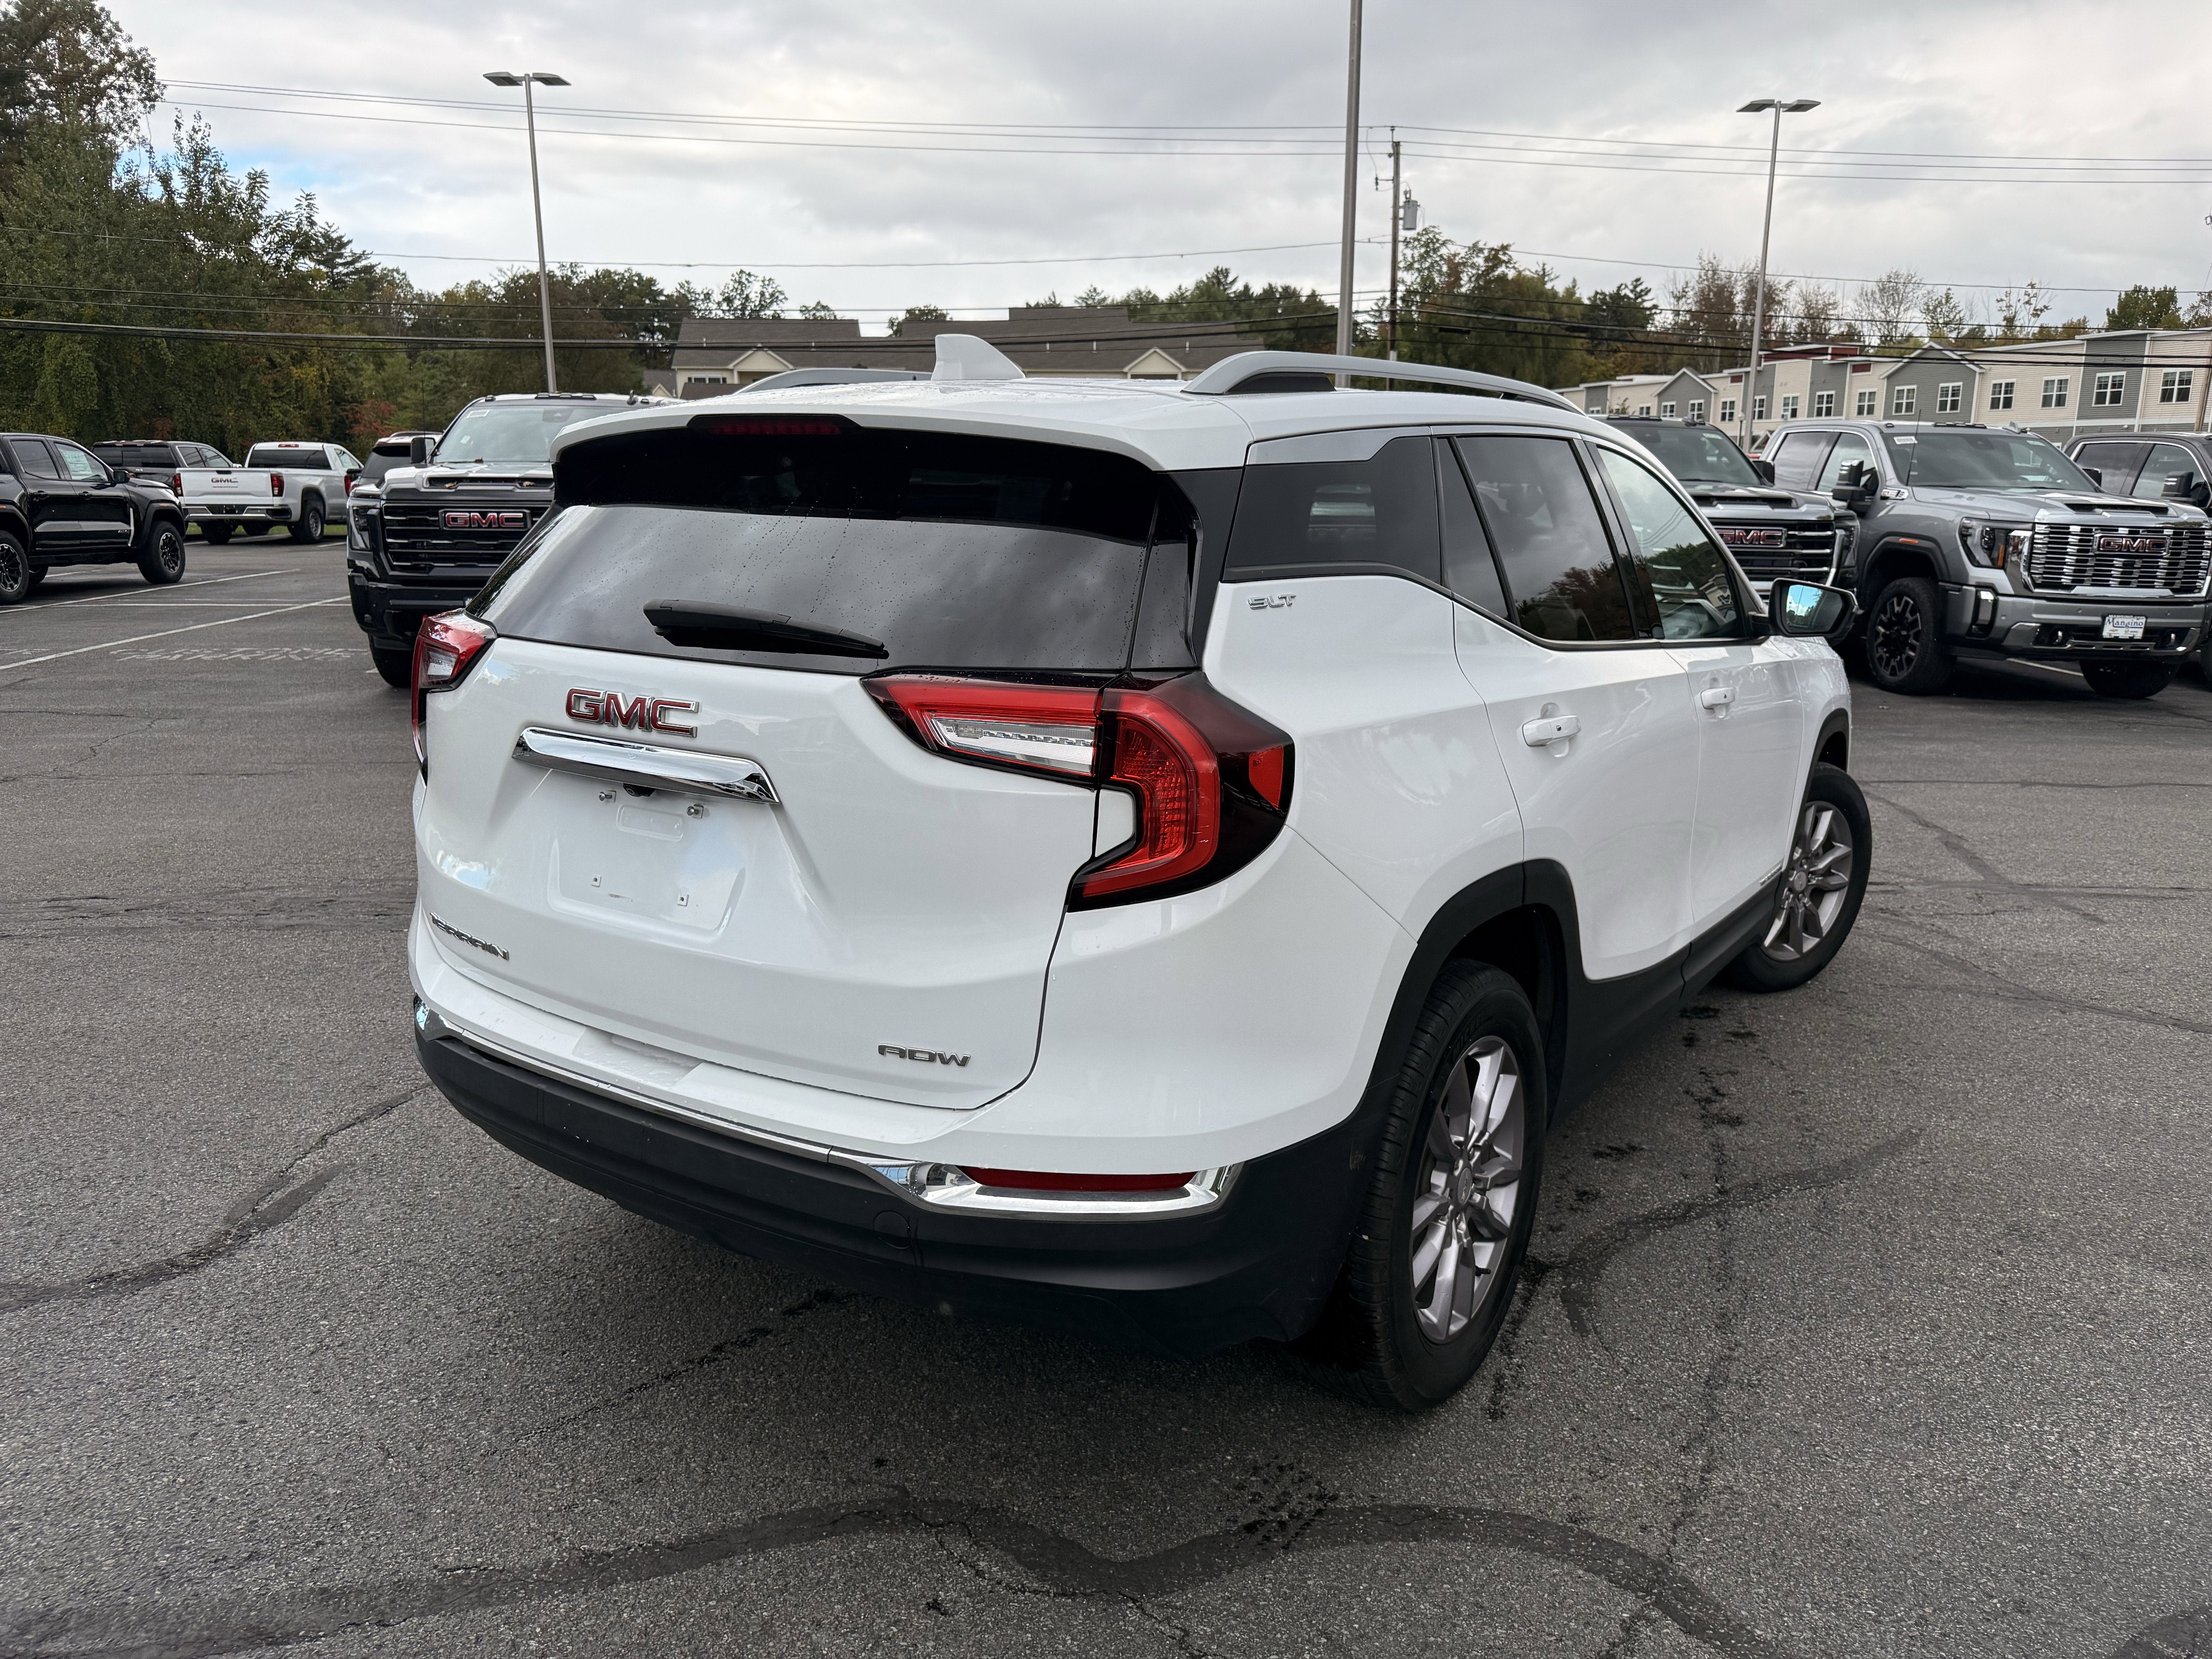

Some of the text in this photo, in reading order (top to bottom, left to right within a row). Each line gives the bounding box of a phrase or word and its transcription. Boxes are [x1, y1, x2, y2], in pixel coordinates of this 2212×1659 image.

[446, 512, 524, 527] GMC
[1716, 529, 1782, 544] GMC
[2100, 538, 2166, 552] GMC
[1248, 594, 1297, 609] SLT
[2105, 618, 2143, 629] Mangino
[566, 687, 699, 737] GMC
[430, 912, 509, 960] TERRAIN
